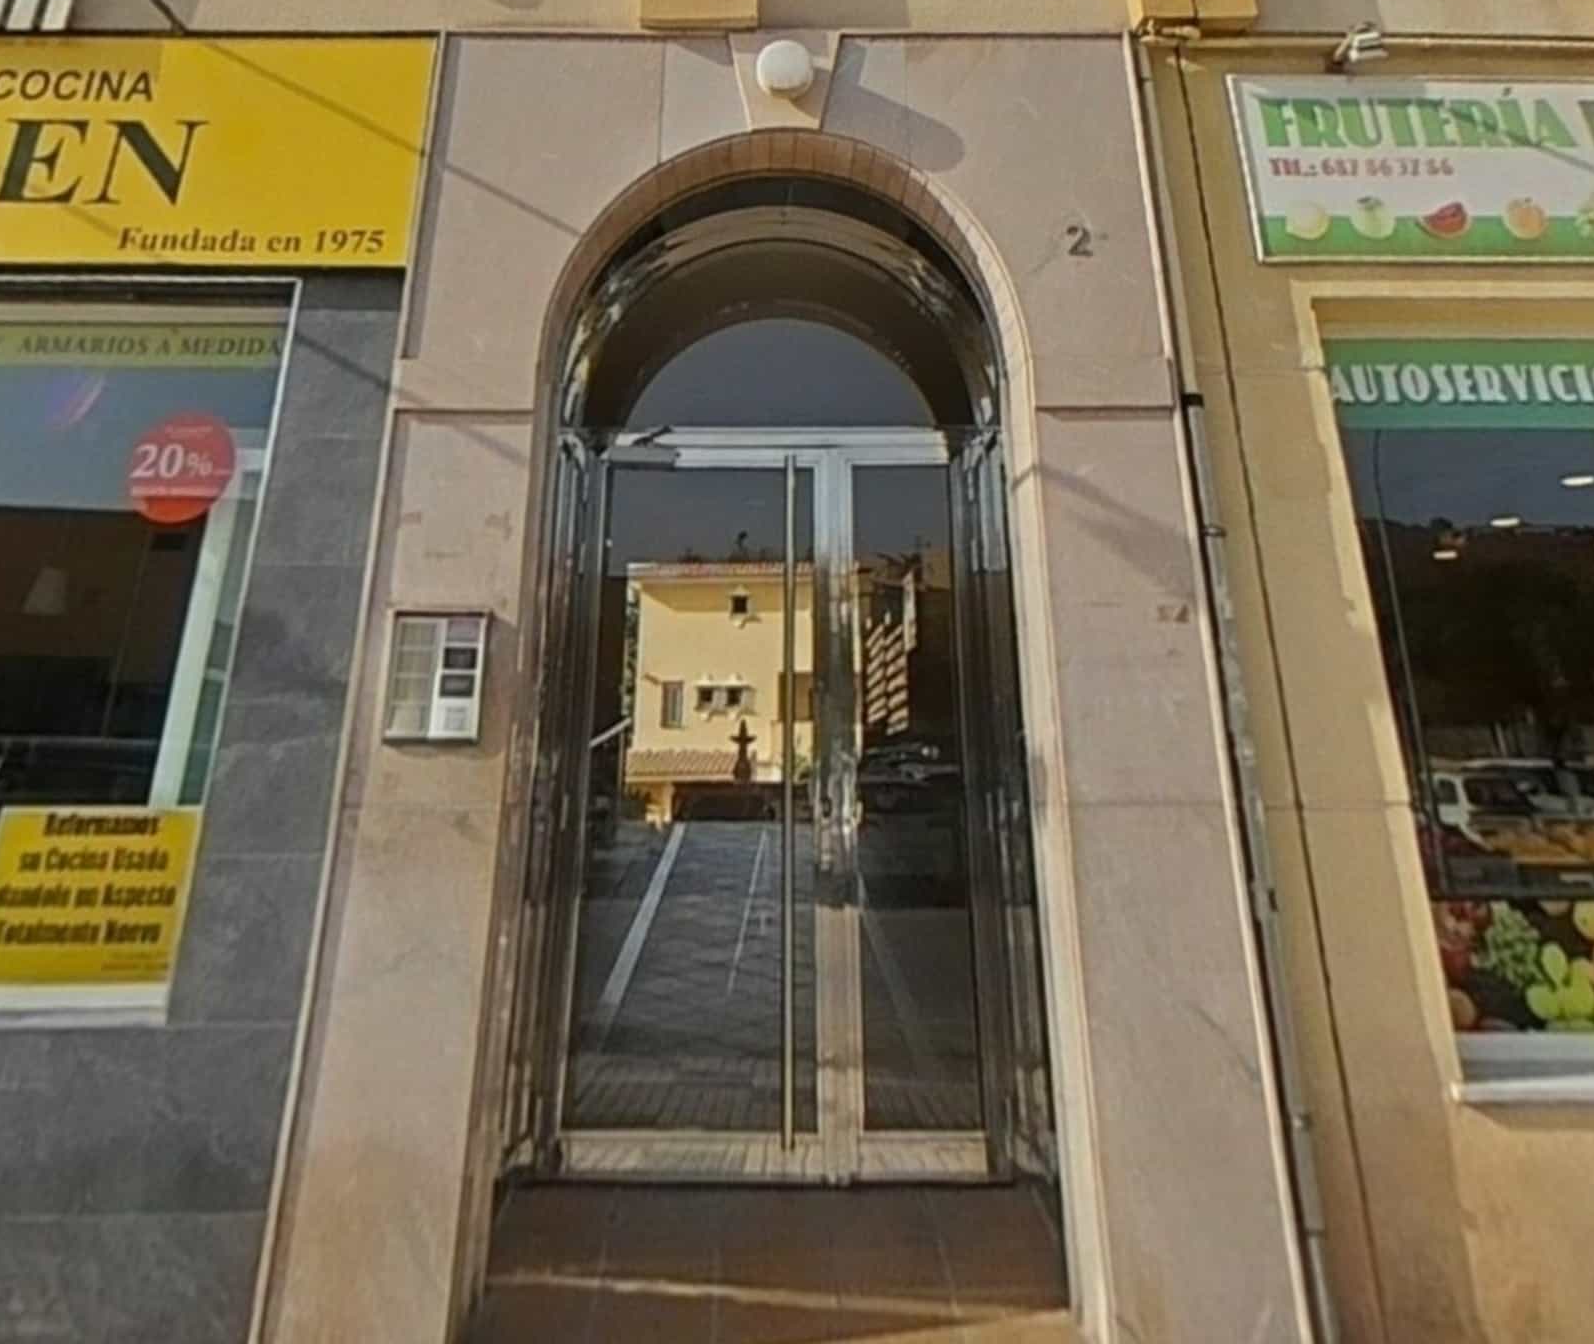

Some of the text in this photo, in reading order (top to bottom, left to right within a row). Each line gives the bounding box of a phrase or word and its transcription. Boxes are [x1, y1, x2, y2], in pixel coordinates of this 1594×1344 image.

[1258, 87, 1577, 148] FRUTERÍA
[118, 226, 386, 255] Fundada en 1975
[1066, 225, 1094, 258] 2
[19, 334, 151, 356] ARMARIOS
[177, 334, 284, 357] MEDIDA
[129, 442, 214, 479] 20%
[43, 846, 110, 872] Cocina
